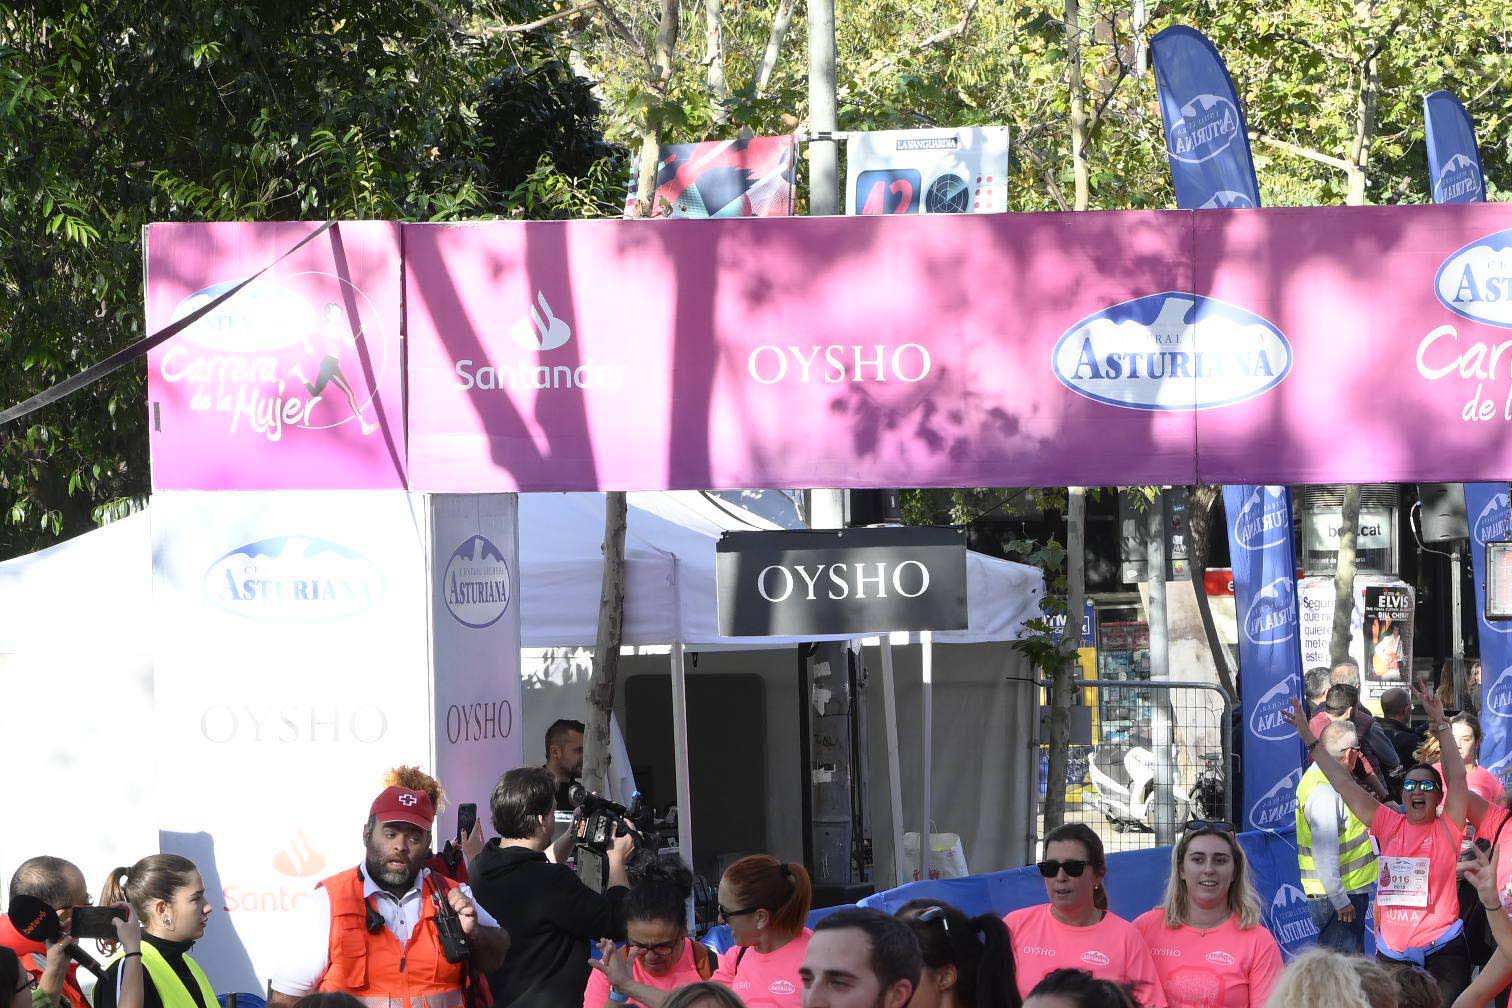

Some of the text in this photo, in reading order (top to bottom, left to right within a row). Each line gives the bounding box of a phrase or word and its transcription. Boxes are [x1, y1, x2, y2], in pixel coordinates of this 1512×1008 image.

[749, 343, 932, 385] OYSHO
[1071, 336, 1275, 380] ASTURIANA
[1461, 384, 1494, 423] de
[449, 570, 507, 605] ASTURIANA
[758, 560, 930, 603] OYSHO
[1378, 595, 1409, 608] ELVIS
[446, 700, 512, 745] OYSHO
[1391, 875, 1410, 884] 016
[1022, 945, 1057, 958] OYSHO
